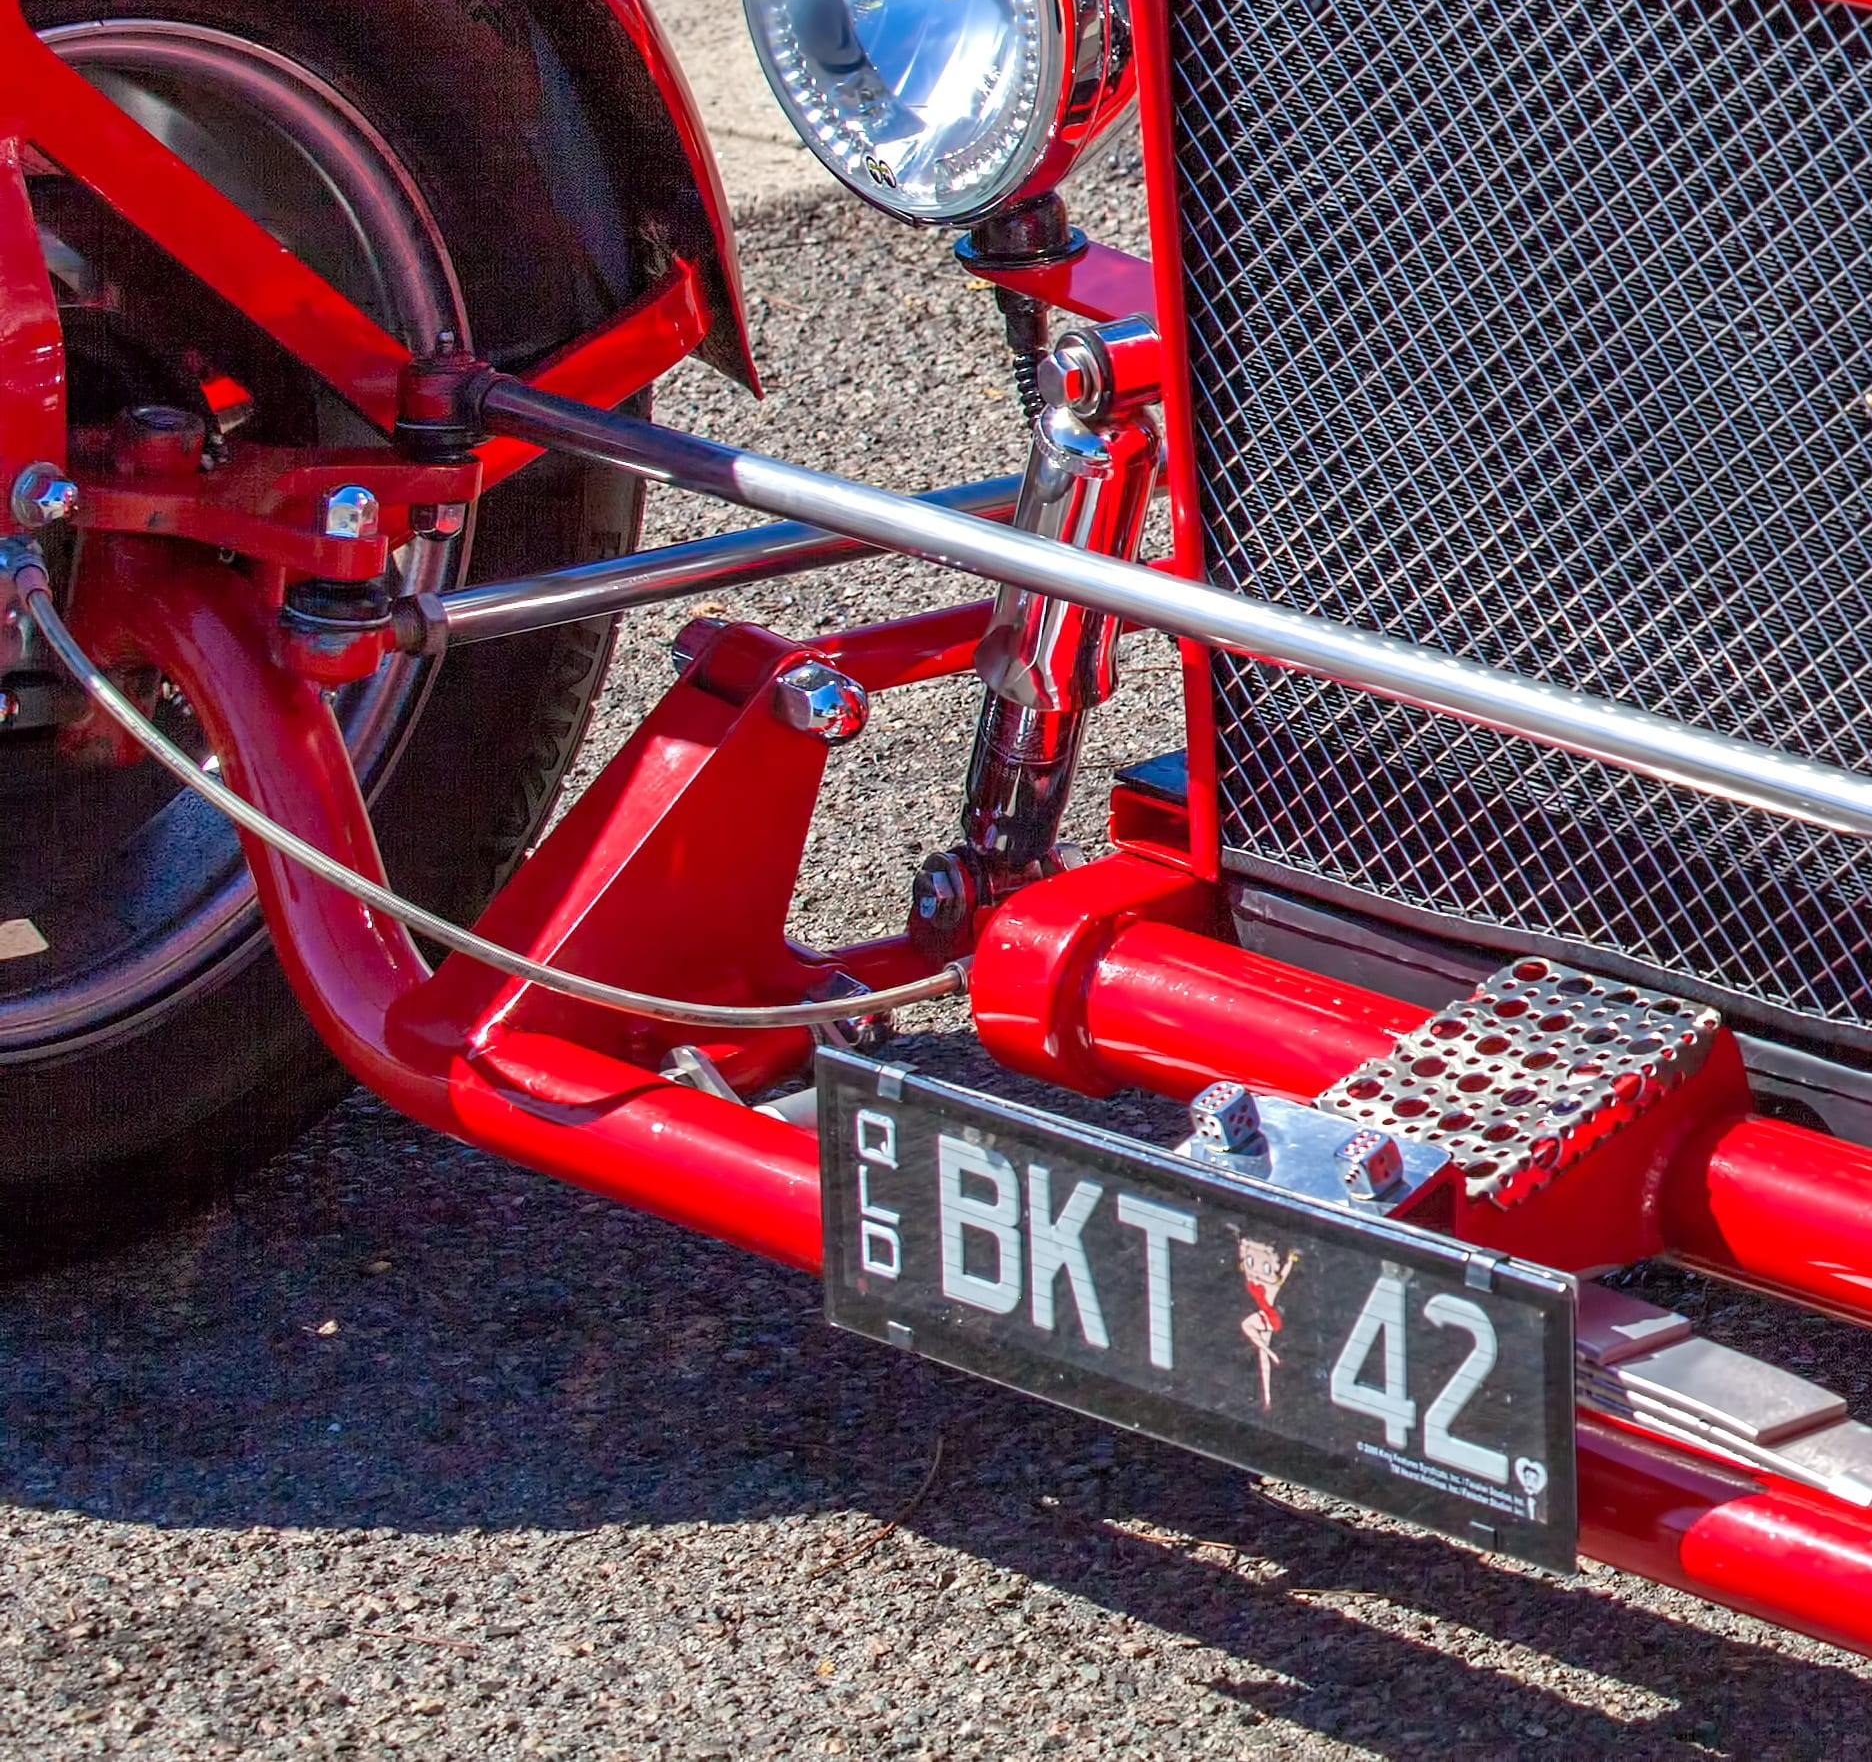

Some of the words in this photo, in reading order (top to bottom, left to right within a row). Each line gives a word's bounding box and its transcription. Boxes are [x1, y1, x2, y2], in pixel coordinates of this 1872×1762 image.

[857, 1108, 901, 1279] QLD
[938, 1133, 1198, 1370] BKT
[1331, 1276, 1510, 1485] 42
